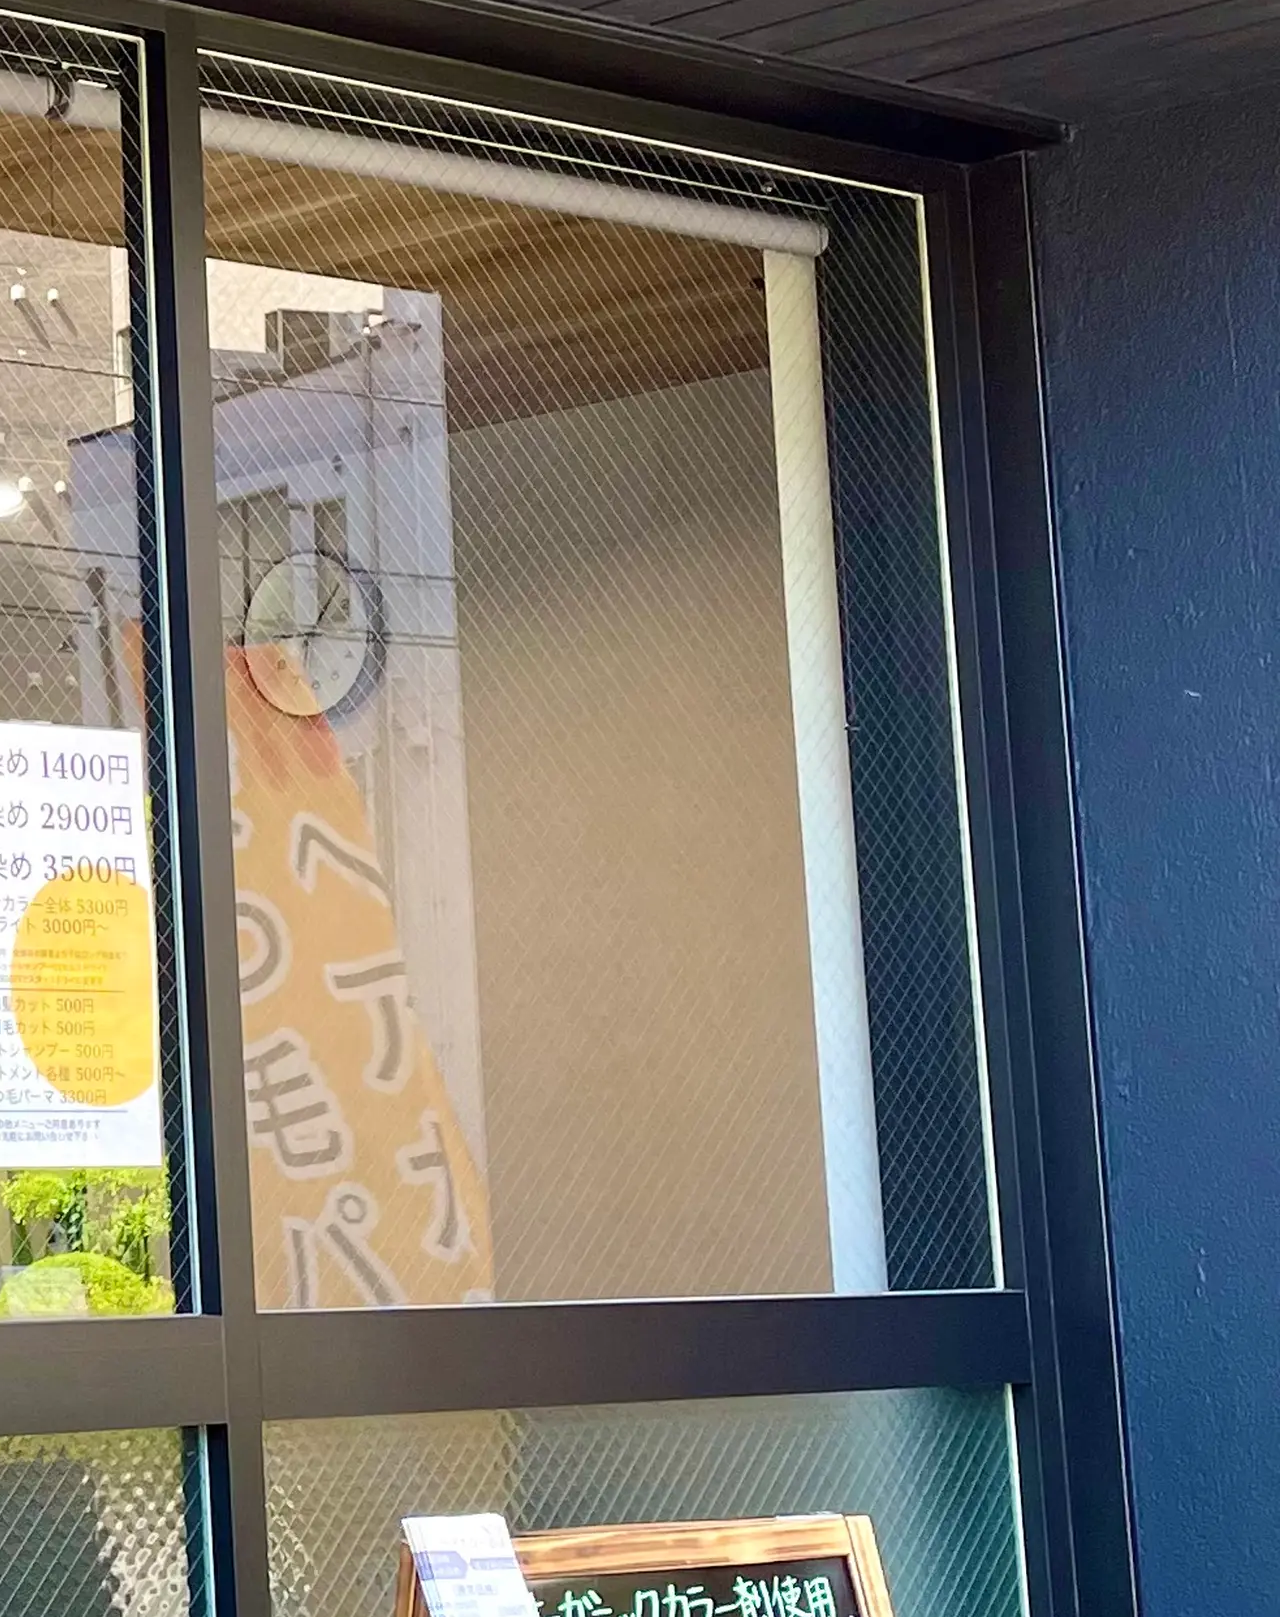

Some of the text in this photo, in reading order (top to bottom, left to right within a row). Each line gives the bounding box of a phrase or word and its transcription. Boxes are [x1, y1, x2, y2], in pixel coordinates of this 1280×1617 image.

[41, 750, 130, 785] 1400円
[40, 802, 133, 836] 2900円
[43, 853, 137, 886] 3500円
[56, 998, 95, 1014] 500円
[56, 1021, 95, 1037] 500円
[76, 1044, 114, 1059] 500円
[59, 1090, 107, 1105] 3300円
